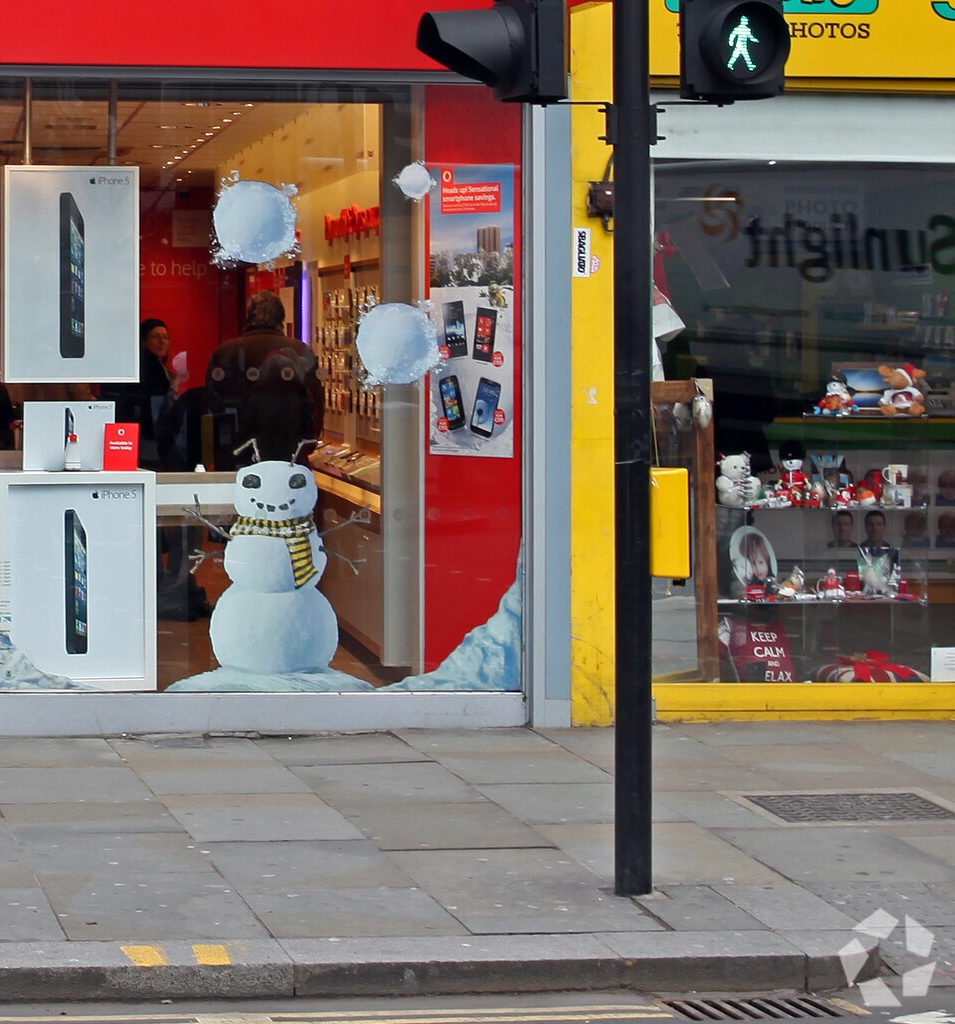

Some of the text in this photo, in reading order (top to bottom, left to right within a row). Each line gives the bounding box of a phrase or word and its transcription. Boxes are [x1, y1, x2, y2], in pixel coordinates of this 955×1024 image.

[789, 22, 870, 38] HOTOS
[98, 176, 123, 185] iPhone
[468, 185, 499, 193] Sensational
[442, 195, 474, 203] smartphone
[785, 201, 858, 215] PHOTO
[150, 261, 166, 276] to
[171, 260, 207, 279] help
[102, 489, 137, 499] iPhone 5
[750, 631, 778, 643] KEEP
[753, 647, 786, 658] CALM
[764, 671, 794, 683] ELAX
